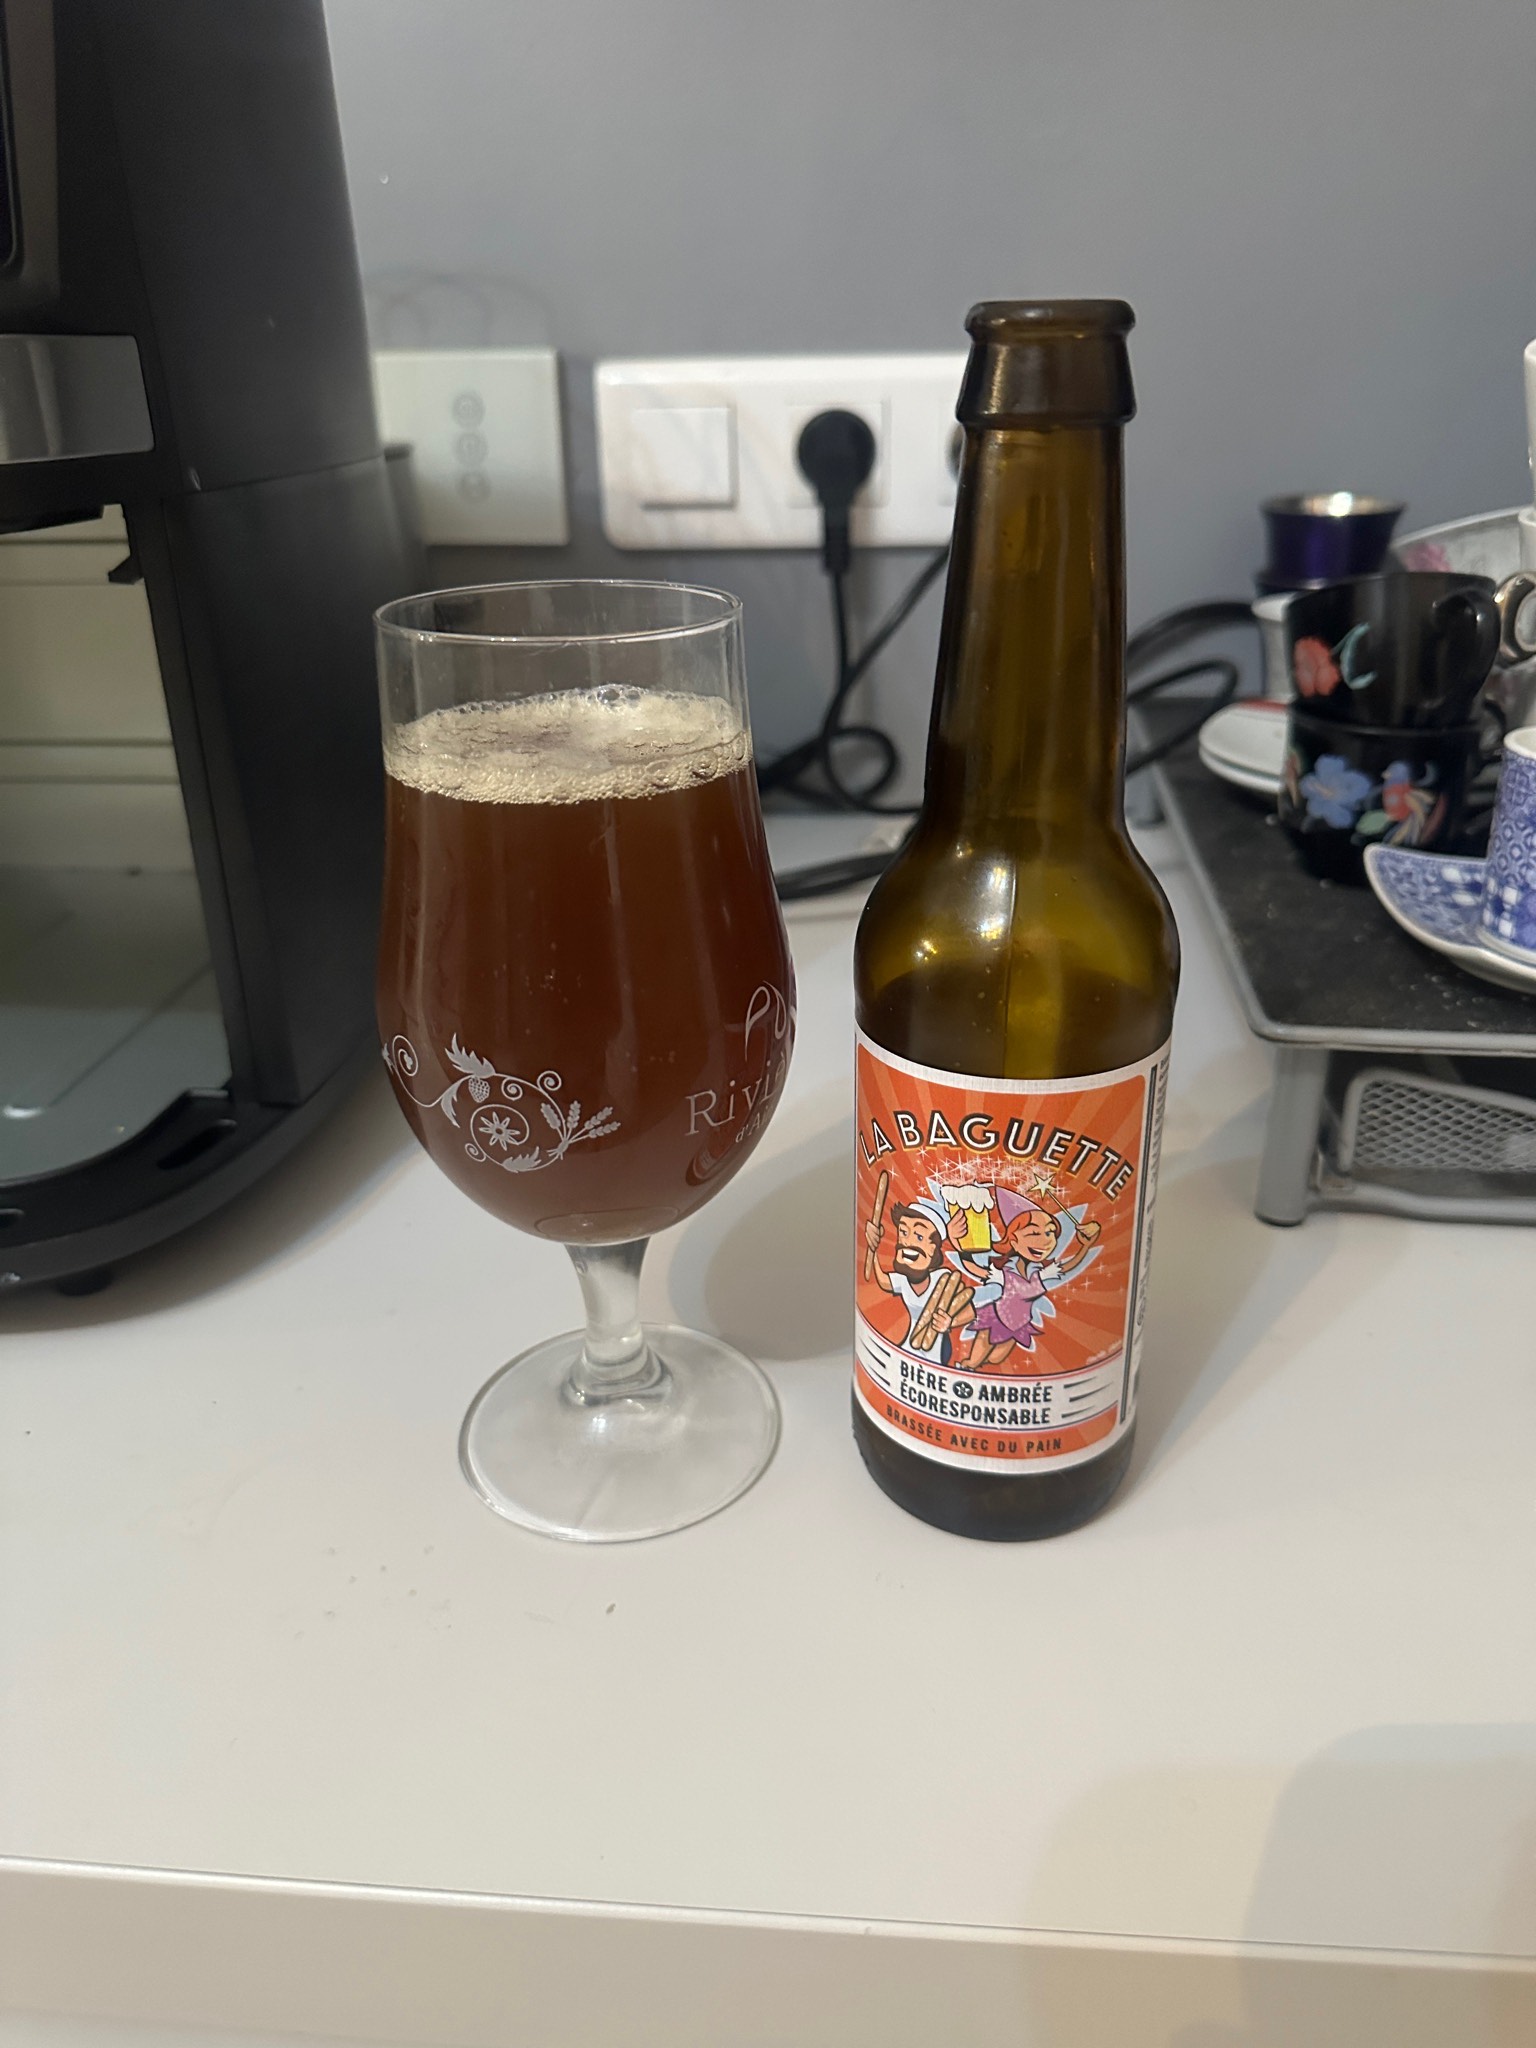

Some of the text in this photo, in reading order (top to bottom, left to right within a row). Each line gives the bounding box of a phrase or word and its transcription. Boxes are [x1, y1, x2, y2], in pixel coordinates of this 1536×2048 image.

[860, 1110, 1134, 1201] LA BAGUETTE
[900, 1361, 1052, 1404] BIÈRE AMBRÉE
[900, 1380, 1051, 1425] ÉCORESPONSABLE
[886, 1404, 1062, 1454] BRASSÉE AVEC DU PAIN
